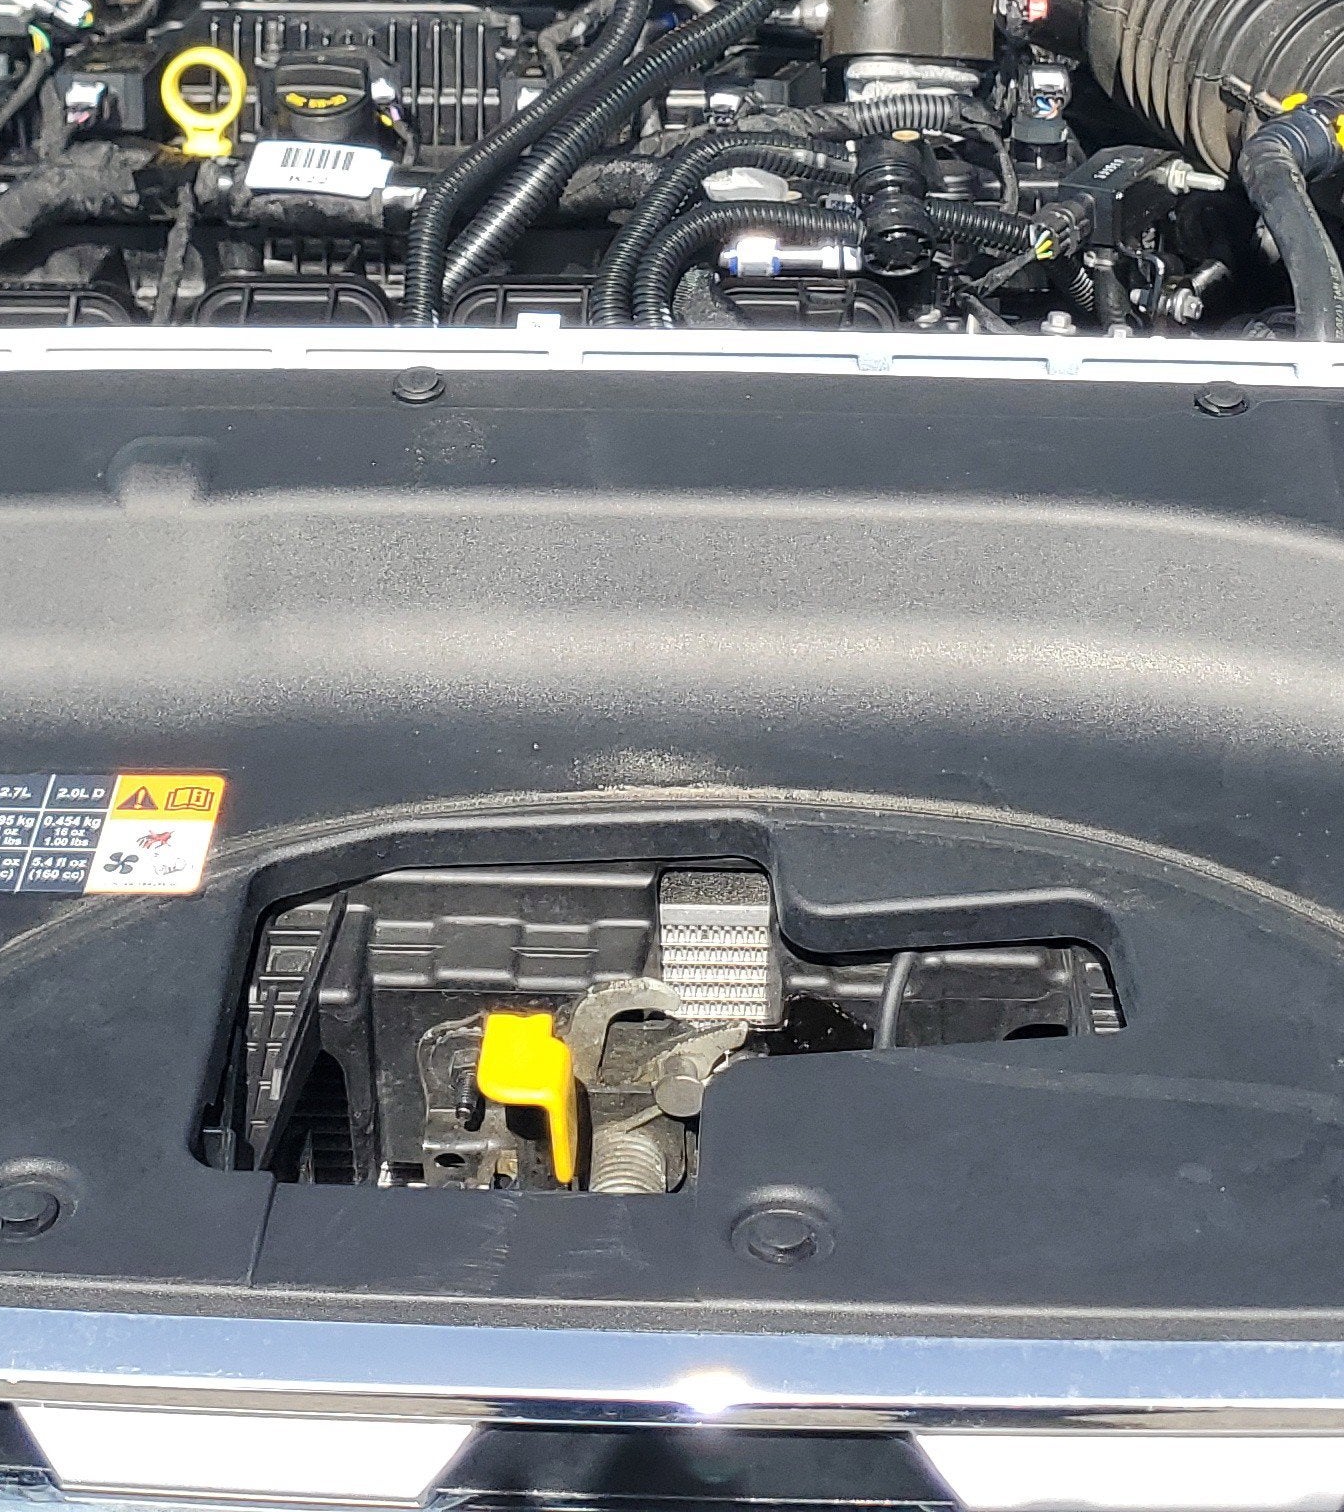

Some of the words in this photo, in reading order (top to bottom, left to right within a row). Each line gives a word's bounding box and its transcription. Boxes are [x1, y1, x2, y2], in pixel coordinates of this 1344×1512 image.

[56, 788, 89, 800] 2.0L
[92, 788, 105, 799] D
[16, 815, 35, 829] kg
[43, 815, 82, 827] 0.454
[83, 816, 102, 829] kg
[3, 828, 19, 836] oz
[53, 828, 69, 837] 16
[70, 829, 86, 837] oz
[3, 836, 22, 846] lbs
[43, 836, 69, 846] 1.00
[70, 837, 89, 847] lbs
[2, 857, 21, 867] oz
[32, 856, 54, 867] 5.4
[55, 856, 67, 867] fl
[69, 858, 88, 867] oz
[28, 868, 60, 880] (160
[62, 869, 85, 882] cc)
